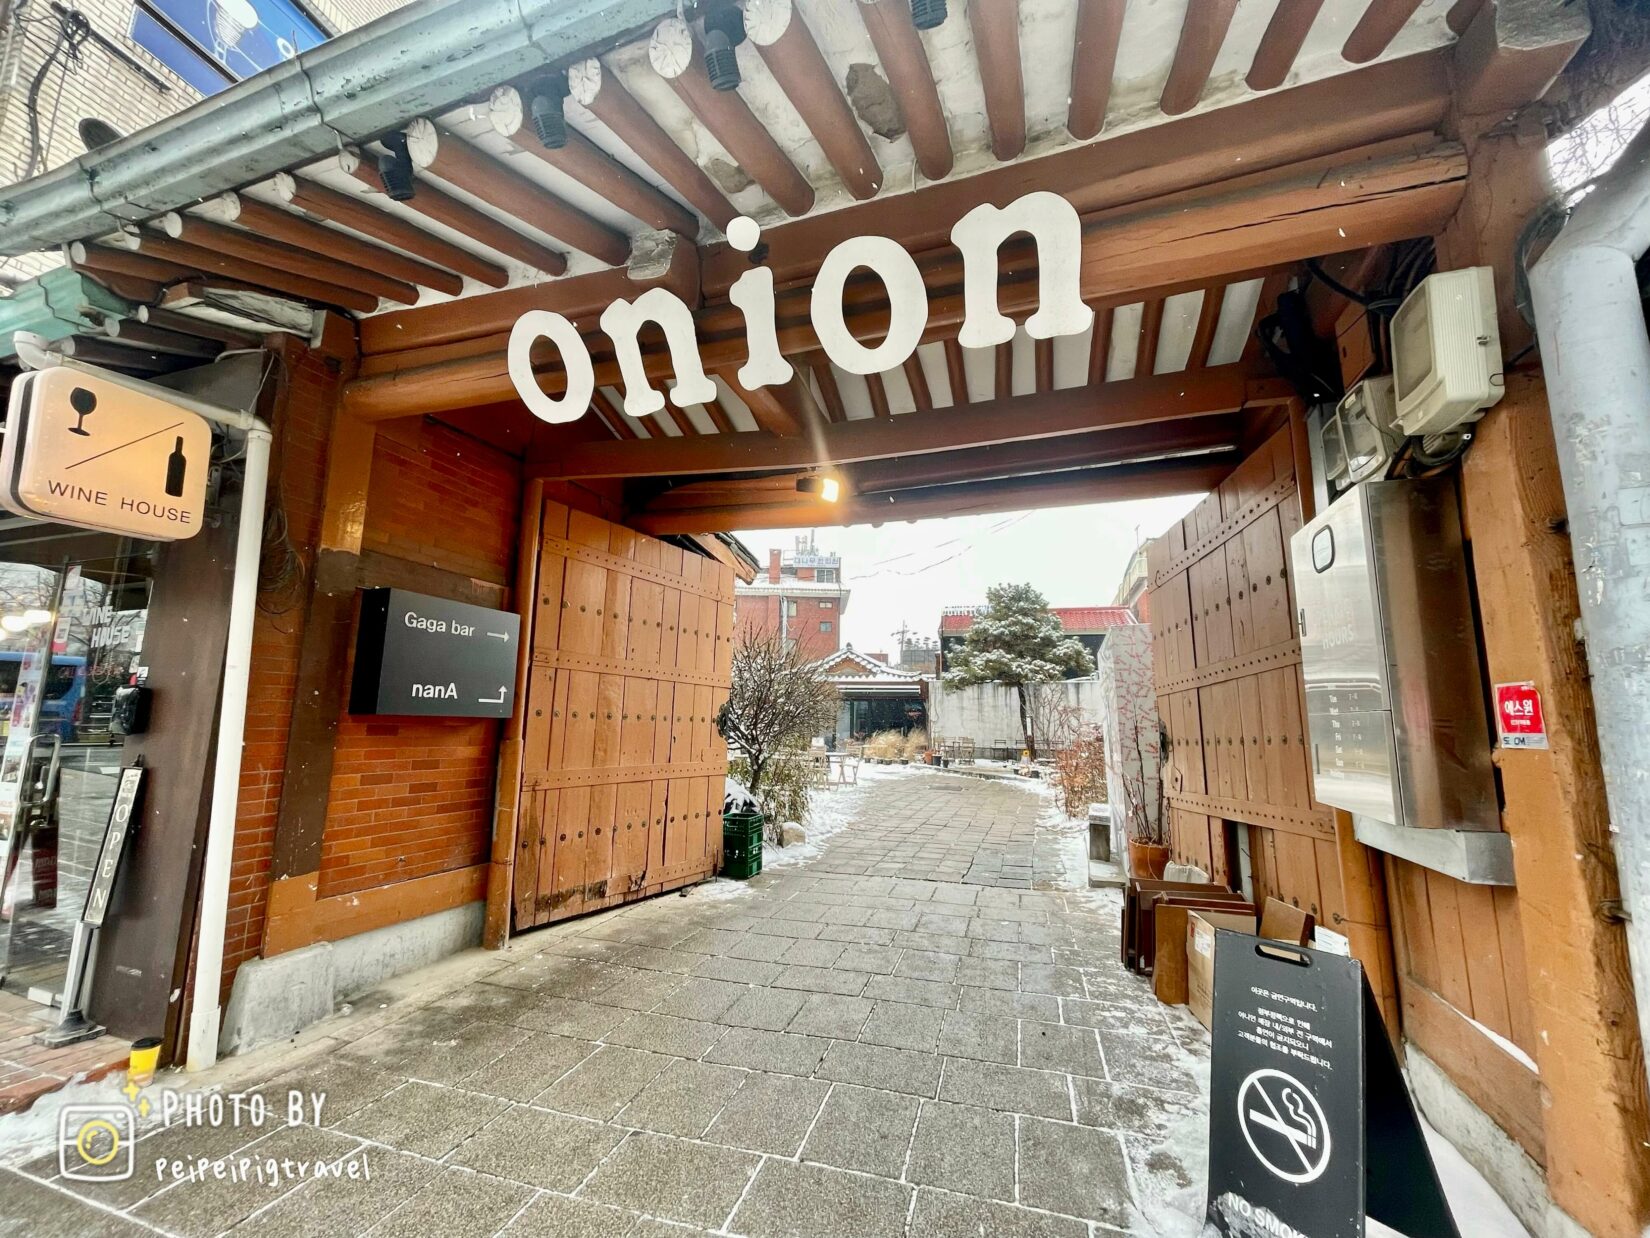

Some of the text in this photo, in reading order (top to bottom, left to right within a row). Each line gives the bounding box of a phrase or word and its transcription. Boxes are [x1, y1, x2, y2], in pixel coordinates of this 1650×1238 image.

[507, 190, 1095, 424] onion
[48, 480, 191, 524] WINE HOUSE
[90, 625, 131, 649] HOUSE
[404, 611, 475, 637] Gaga bar
[411, 682, 458, 700] nanA
[1504, 699, 1534, 716] 에스원
[92, 804, 129, 909] OPEN
[1250, 986, 1270, 999] 이곳은
[1228, 1191, 1251, 1218] NO
